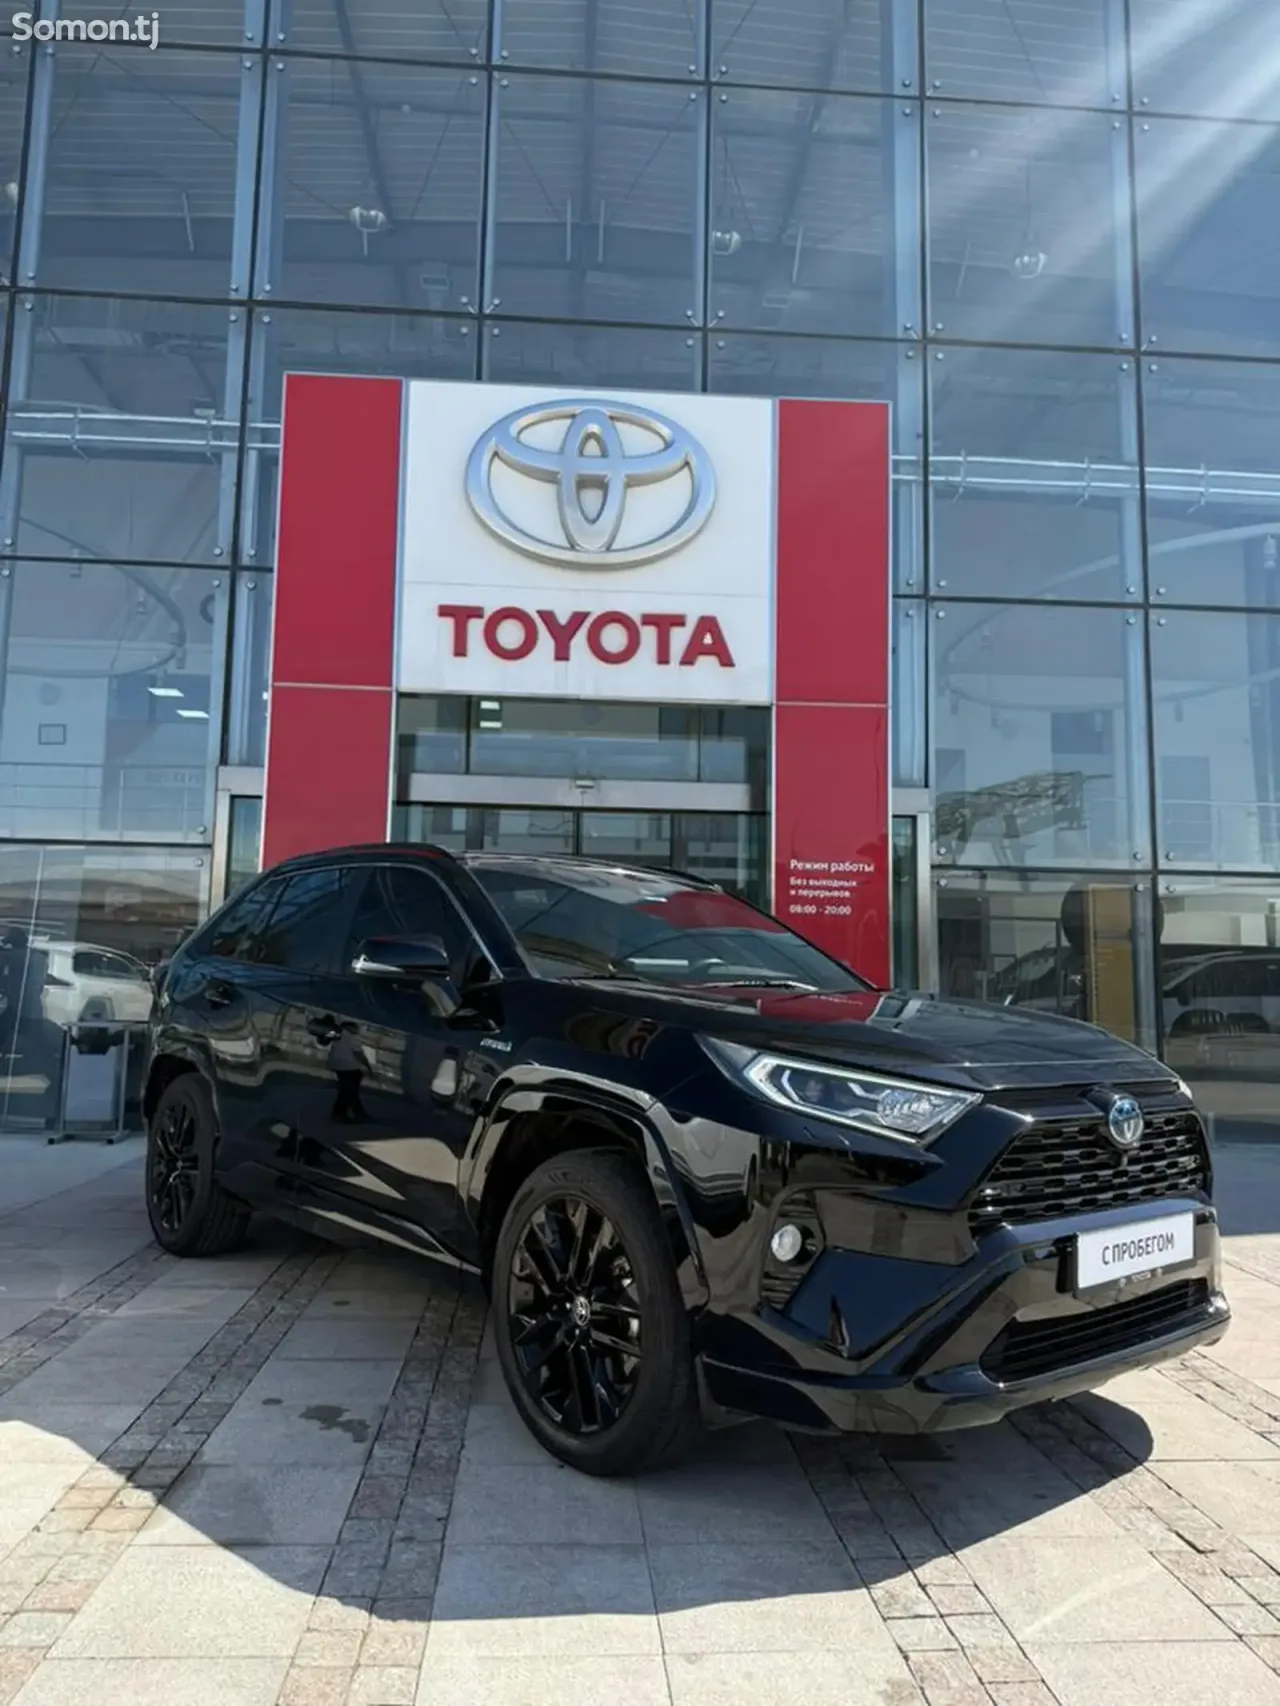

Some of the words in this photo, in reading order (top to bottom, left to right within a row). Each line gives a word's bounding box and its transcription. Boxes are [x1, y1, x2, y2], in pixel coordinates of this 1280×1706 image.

[437, 604, 736, 668] TOYOTA
[790, 859, 829, 871] Режим
[830, 861, 875, 873] работы
[789, 876, 807, 886] Без
[789, 903, 817, 914] 08:00
[824, 905, 852, 916] 20:00
[1102, 1245, 1110, 1266] С
[1112, 1232, 1175, 1263] ПРОБЕГОМ
